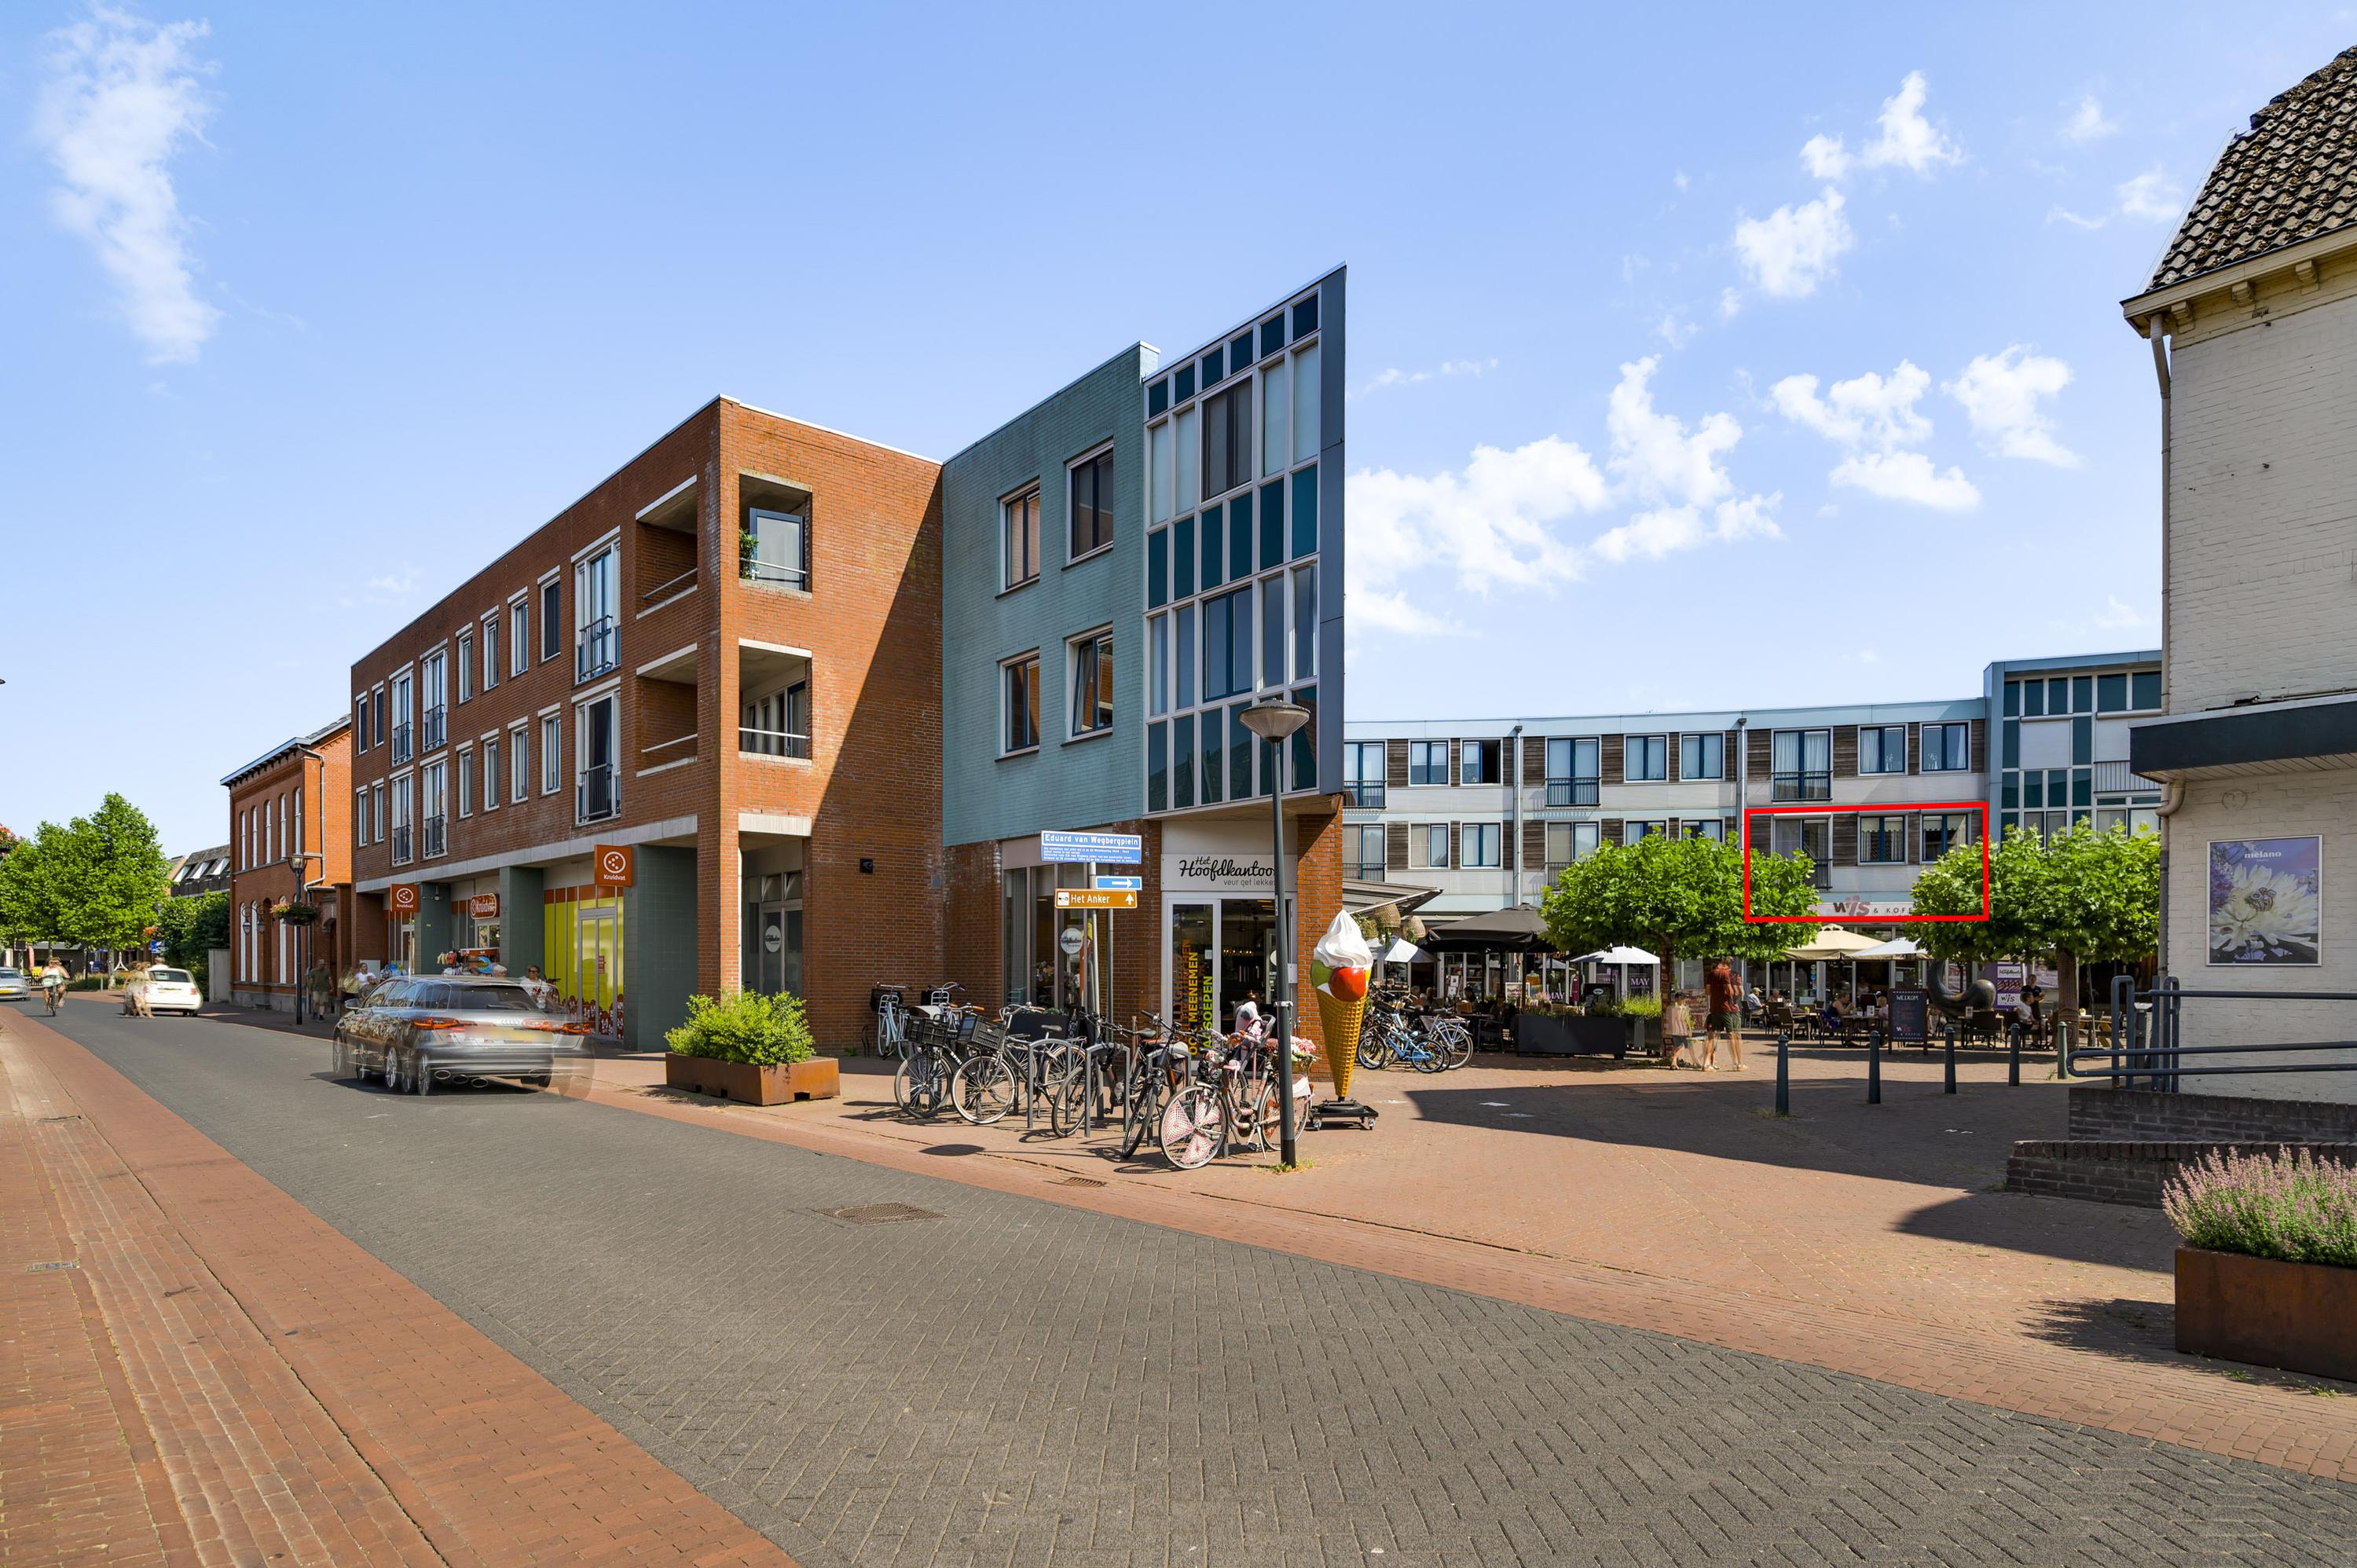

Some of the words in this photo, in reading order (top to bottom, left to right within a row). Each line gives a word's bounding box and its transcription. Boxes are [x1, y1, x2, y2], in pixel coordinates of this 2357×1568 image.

[1045, 833, 1072, 842] Eduard
[1091, 837, 1138, 846] Wegbergplein
[1195, 855, 1211, 865] Het
[1178, 859, 1275, 881] Hoofdkantoo
[1071, 894, 1085, 904] Het
[1087, 894, 1110, 904] Anker
[1188, 951, 1198, 1022] MEENEMEN
